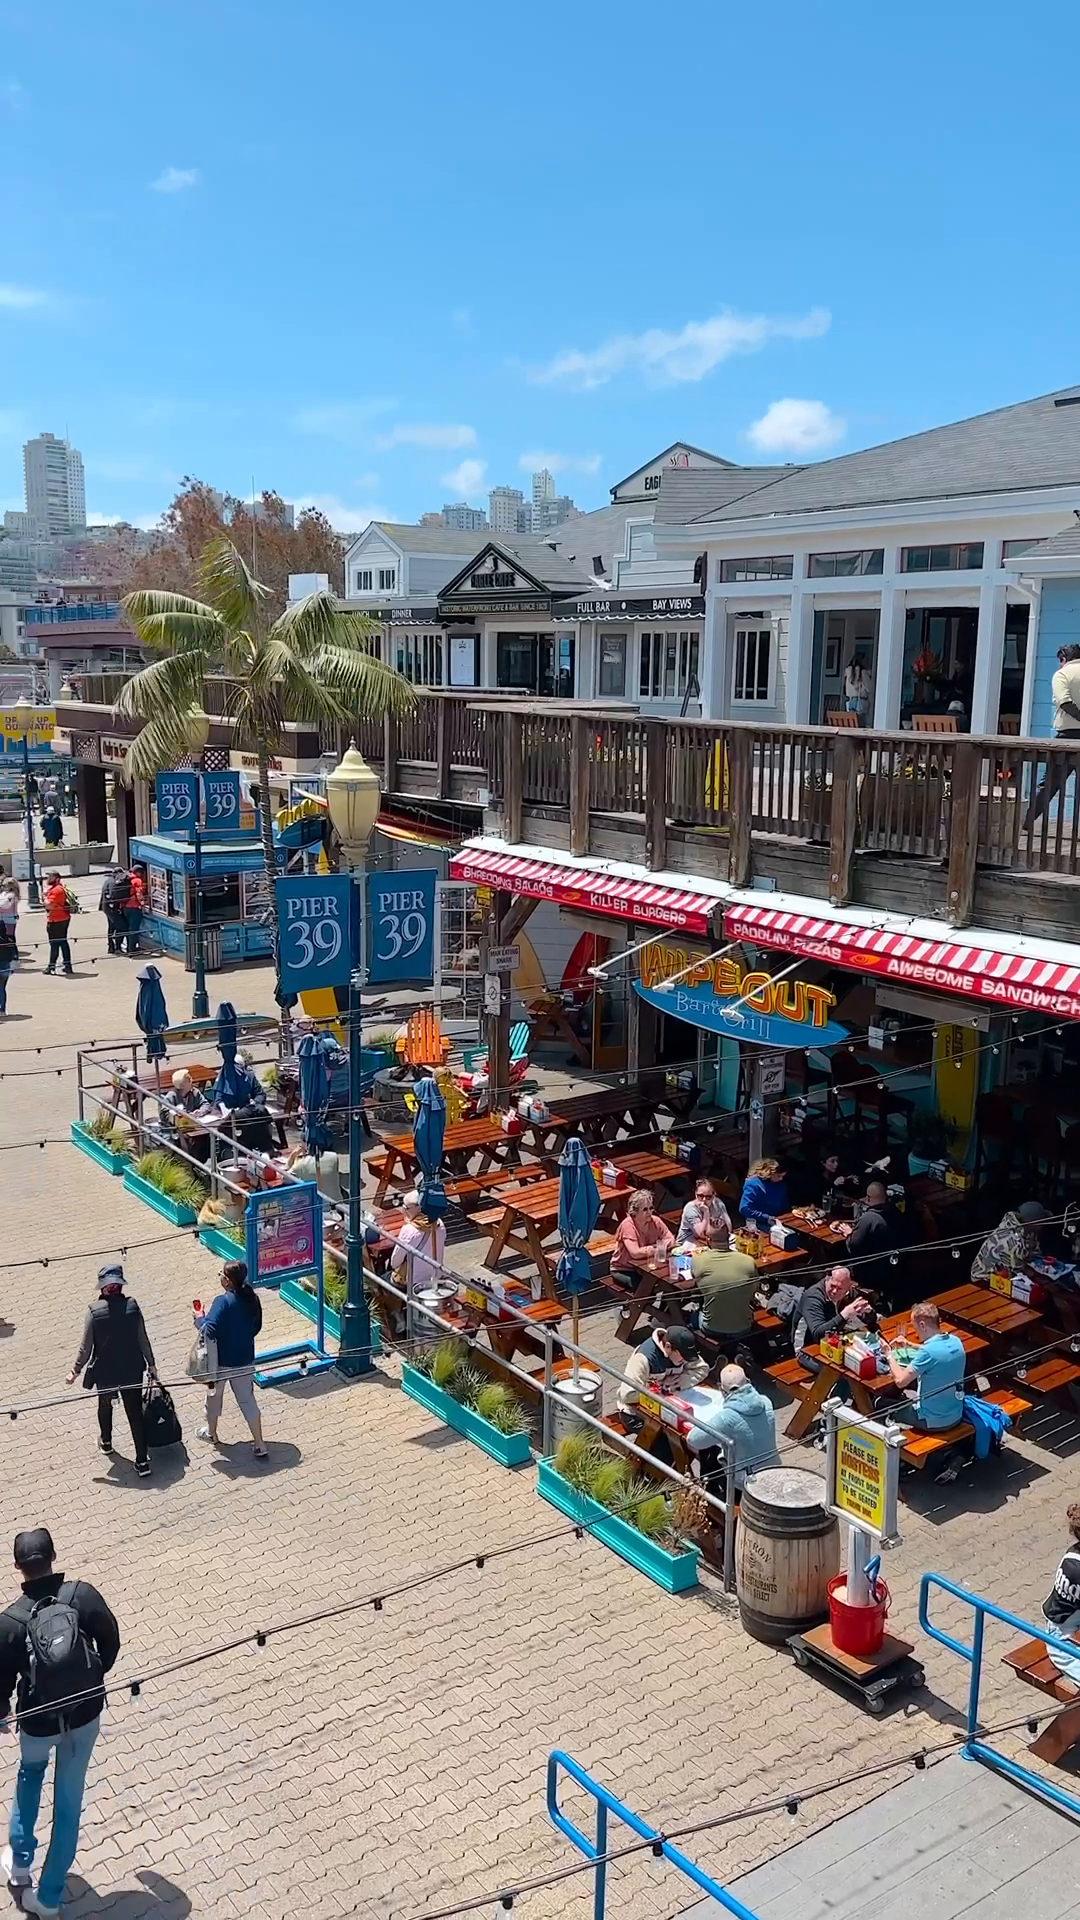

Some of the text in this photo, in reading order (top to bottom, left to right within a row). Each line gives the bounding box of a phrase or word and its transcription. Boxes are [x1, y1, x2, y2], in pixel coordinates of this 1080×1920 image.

[391, 609, 412, 619] DINNER
[577, 601, 610, 613] FULL BAR
[652, 598, 692, 611] BAY VIEWS
[161, 783, 190, 794] PIER
[209, 782, 235, 793] PIER
[161, 795, 192, 820] 39
[208, 794, 236, 818] 39
[286, 896, 339, 919] PIER
[378, 890, 426, 913] PIER
[463, 866, 687, 925] SHREDDING SALADS KILLER BURGERS
[287, 919, 342, 969] 39
[377, 912, 427, 961] 39
[793, 937, 842, 960] PIZZAS
[887, 960, 973, 990] AWESOME
[639, 942, 837, 1029] WIPEOUT
[675, 991, 711, 1015] Bar
[843, 1440, 879, 1467] PLEASE SEE
[841, 1451, 879, 1484] HOSTESS
[840, 1468, 880, 1496] AT FRONT DOOR
[842, 1483, 877, 1509] TO BE SEATED
